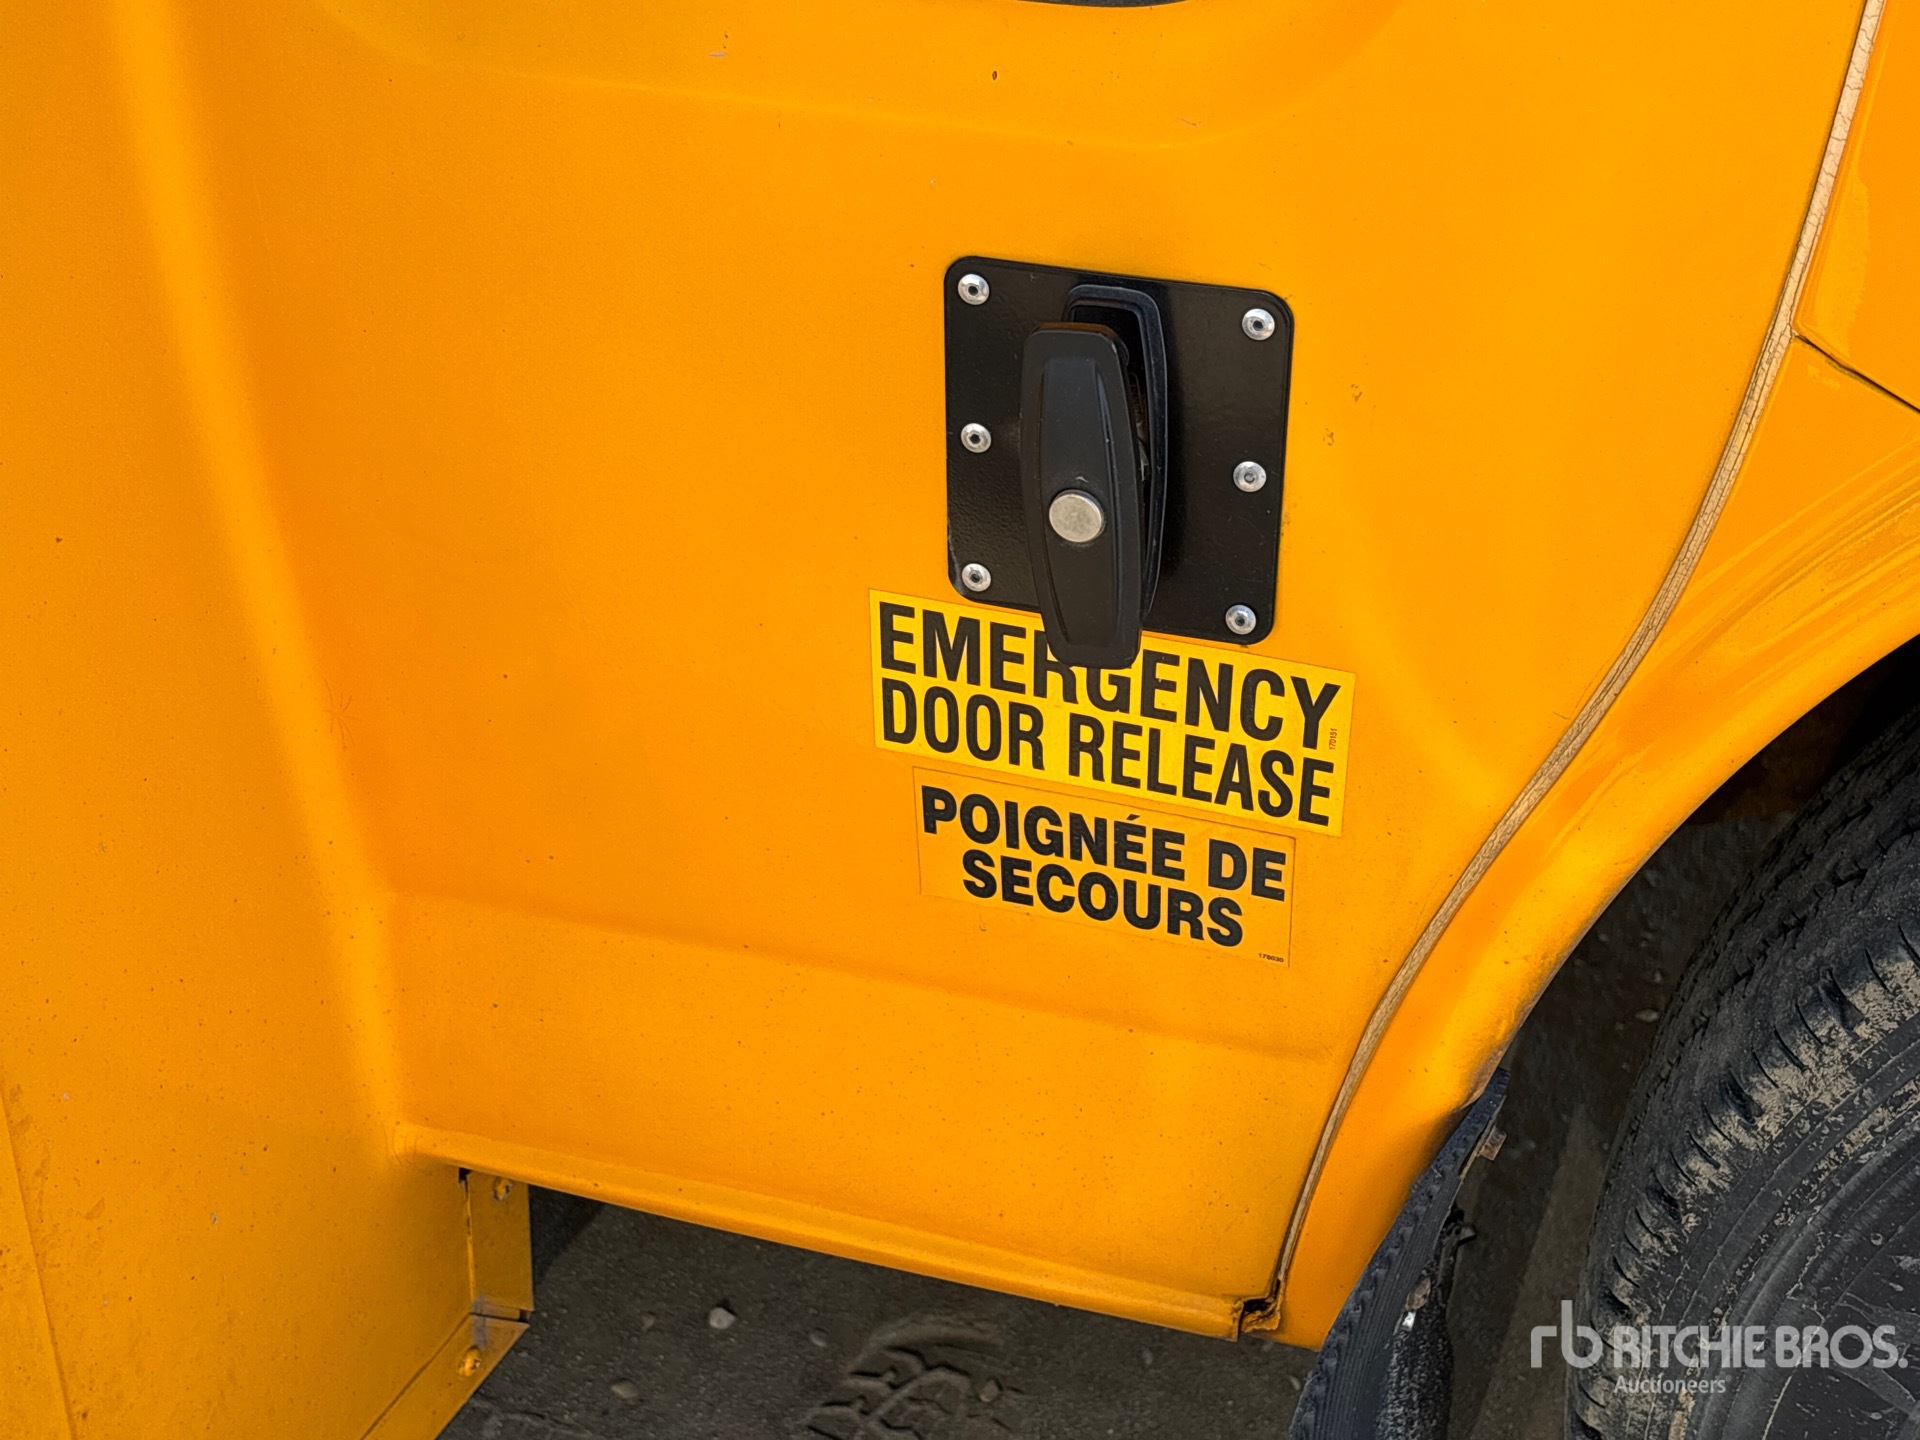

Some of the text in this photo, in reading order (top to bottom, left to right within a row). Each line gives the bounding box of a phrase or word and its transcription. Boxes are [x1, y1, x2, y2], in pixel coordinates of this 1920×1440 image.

[879, 601, 1341, 750] EMERGENCY
[881, 678, 1334, 827] DOOR RELEASE
[921, 784, 1286, 902] POIGNÉE DE
[962, 849, 1243, 947] SECOURS
